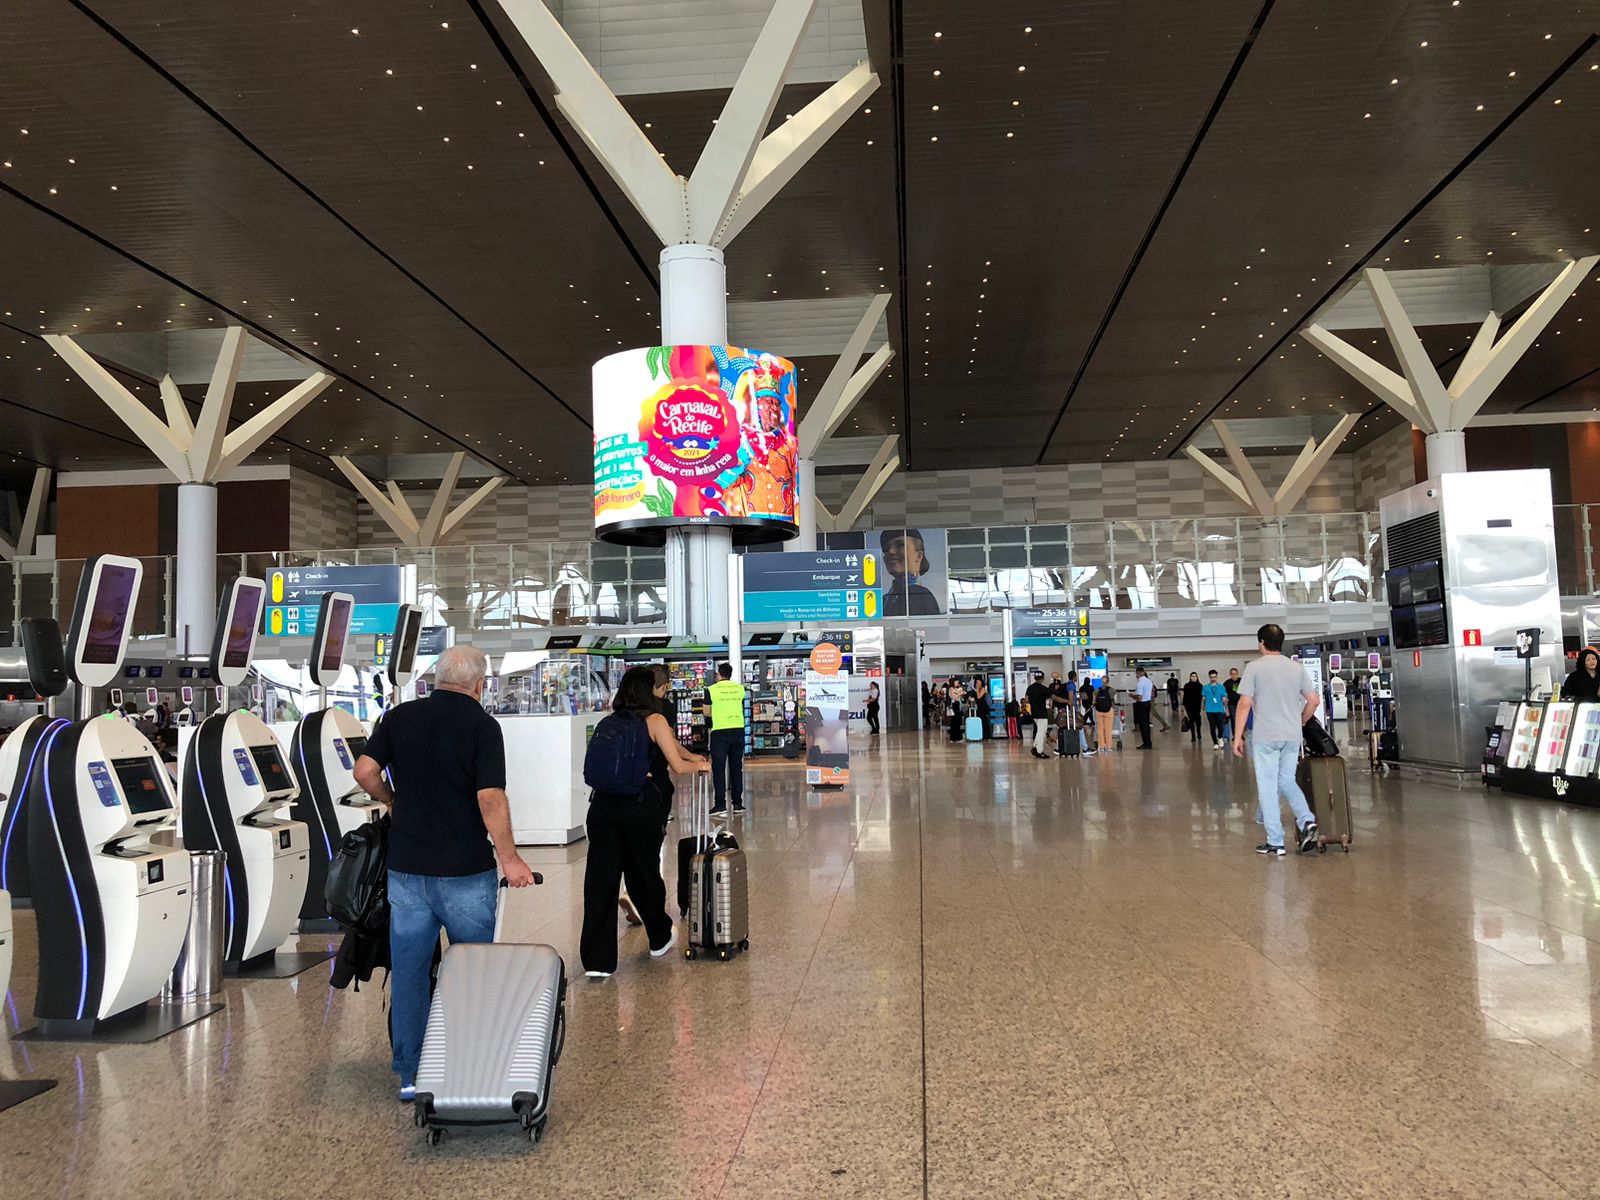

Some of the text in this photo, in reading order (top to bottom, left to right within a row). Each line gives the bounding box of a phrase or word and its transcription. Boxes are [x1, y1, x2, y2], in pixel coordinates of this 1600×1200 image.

[659, 402, 721, 419] Carnaval
[685, 413, 695, 421] do
[662, 416, 713, 435] Recife
[654, 459, 679, 474] maior
[680, 468, 694, 476] em
[695, 463, 716, 476] linha
[715, 453, 732, 468] reta
